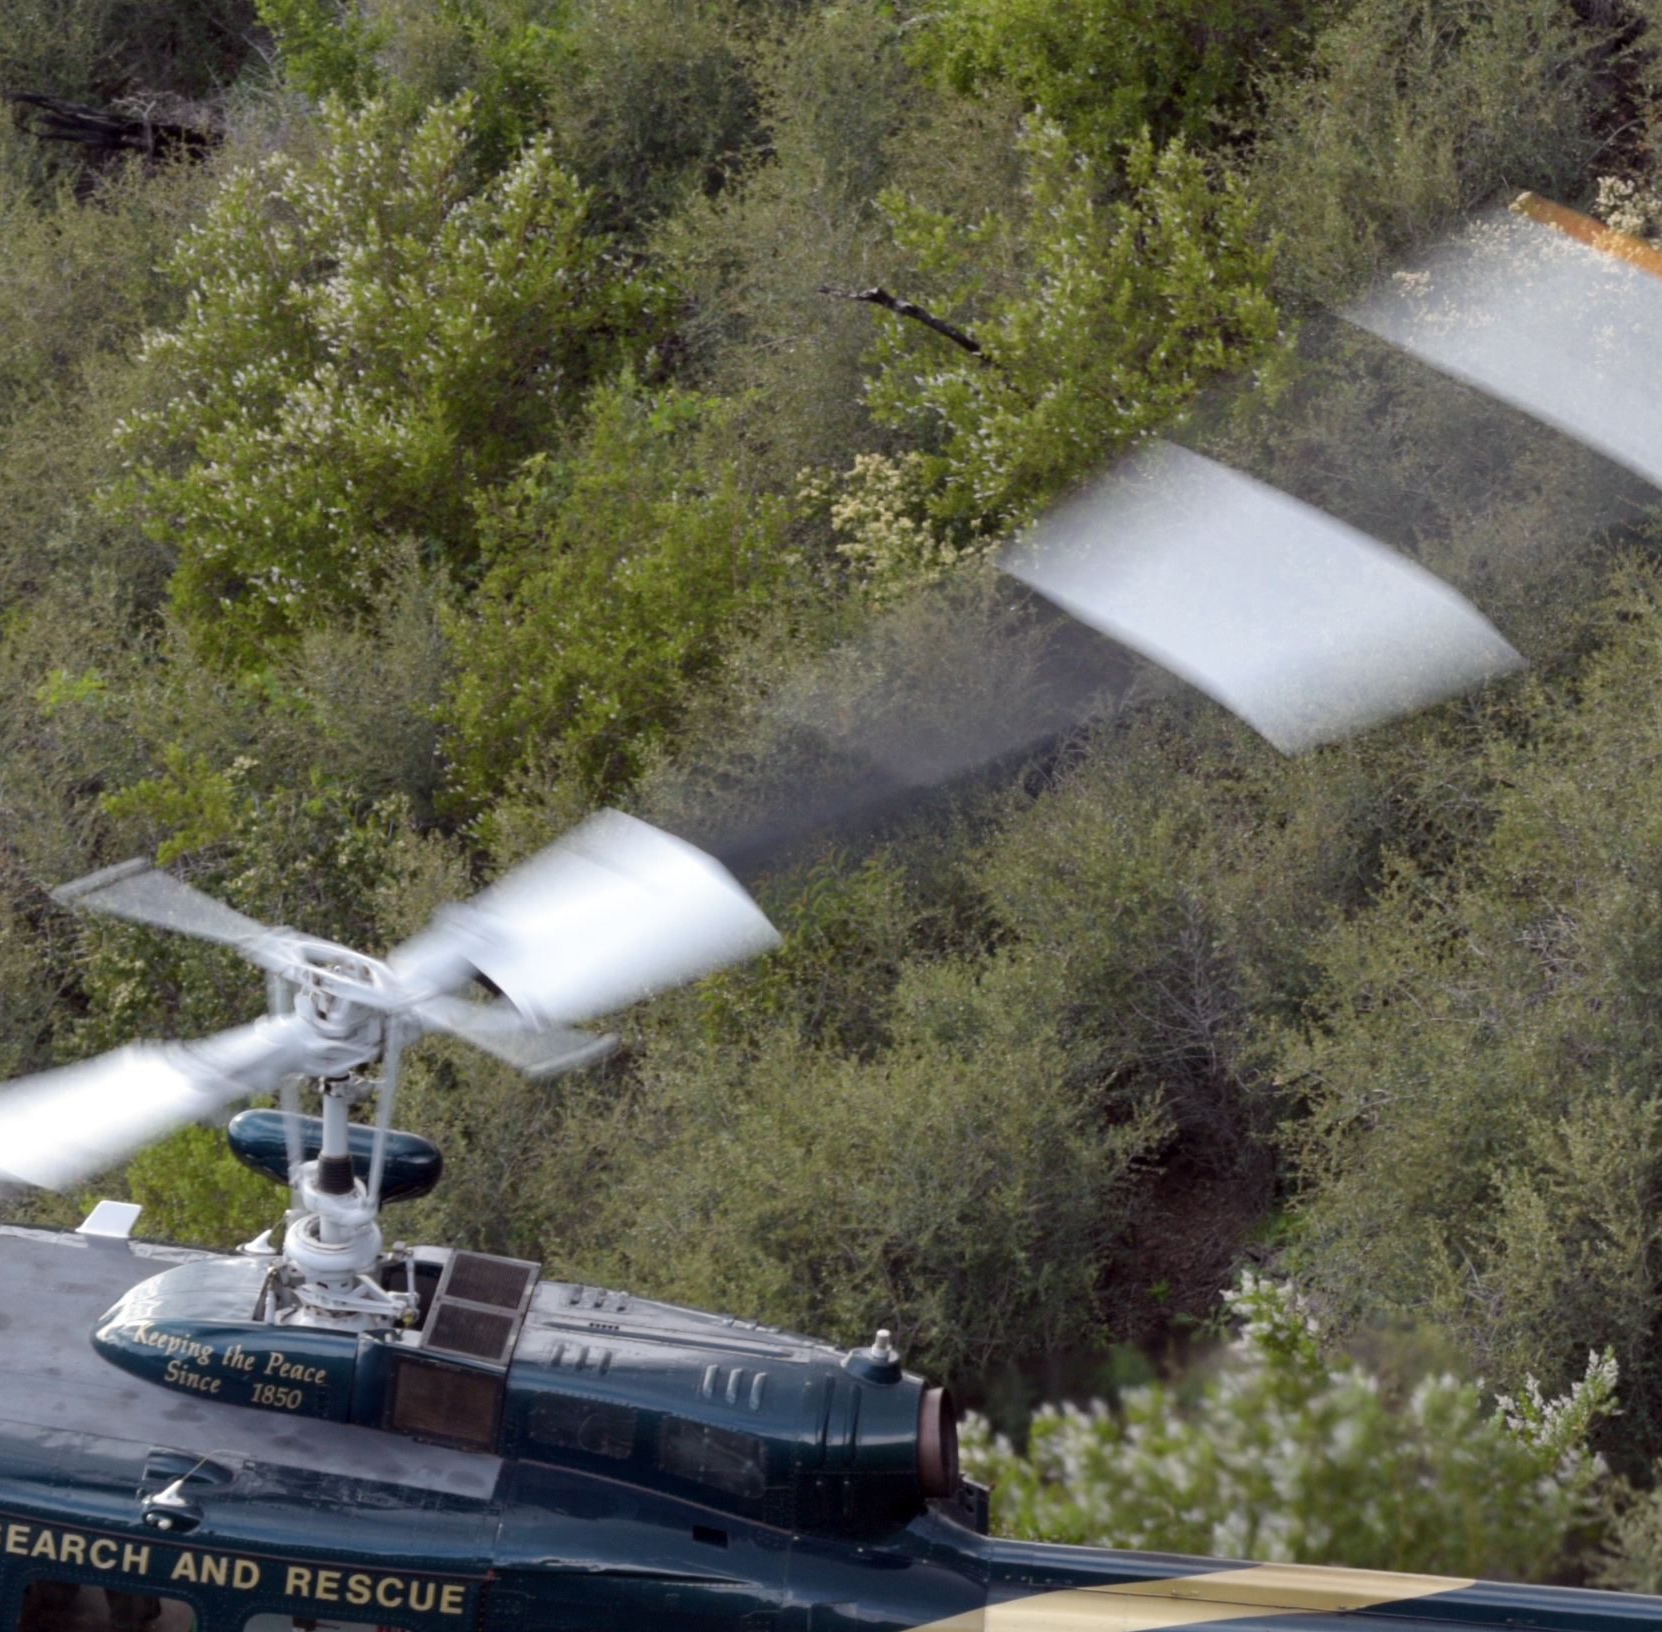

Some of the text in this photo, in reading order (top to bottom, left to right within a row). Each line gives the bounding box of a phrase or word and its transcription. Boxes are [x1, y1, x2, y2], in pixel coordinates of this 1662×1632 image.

[133, 1324, 327, 1384] Keeping the Peace
[164, 1360, 303, 1410] Since 1850
[171, 1552, 261, 1590] AND
[285, 1567, 466, 1615] RESCUE
